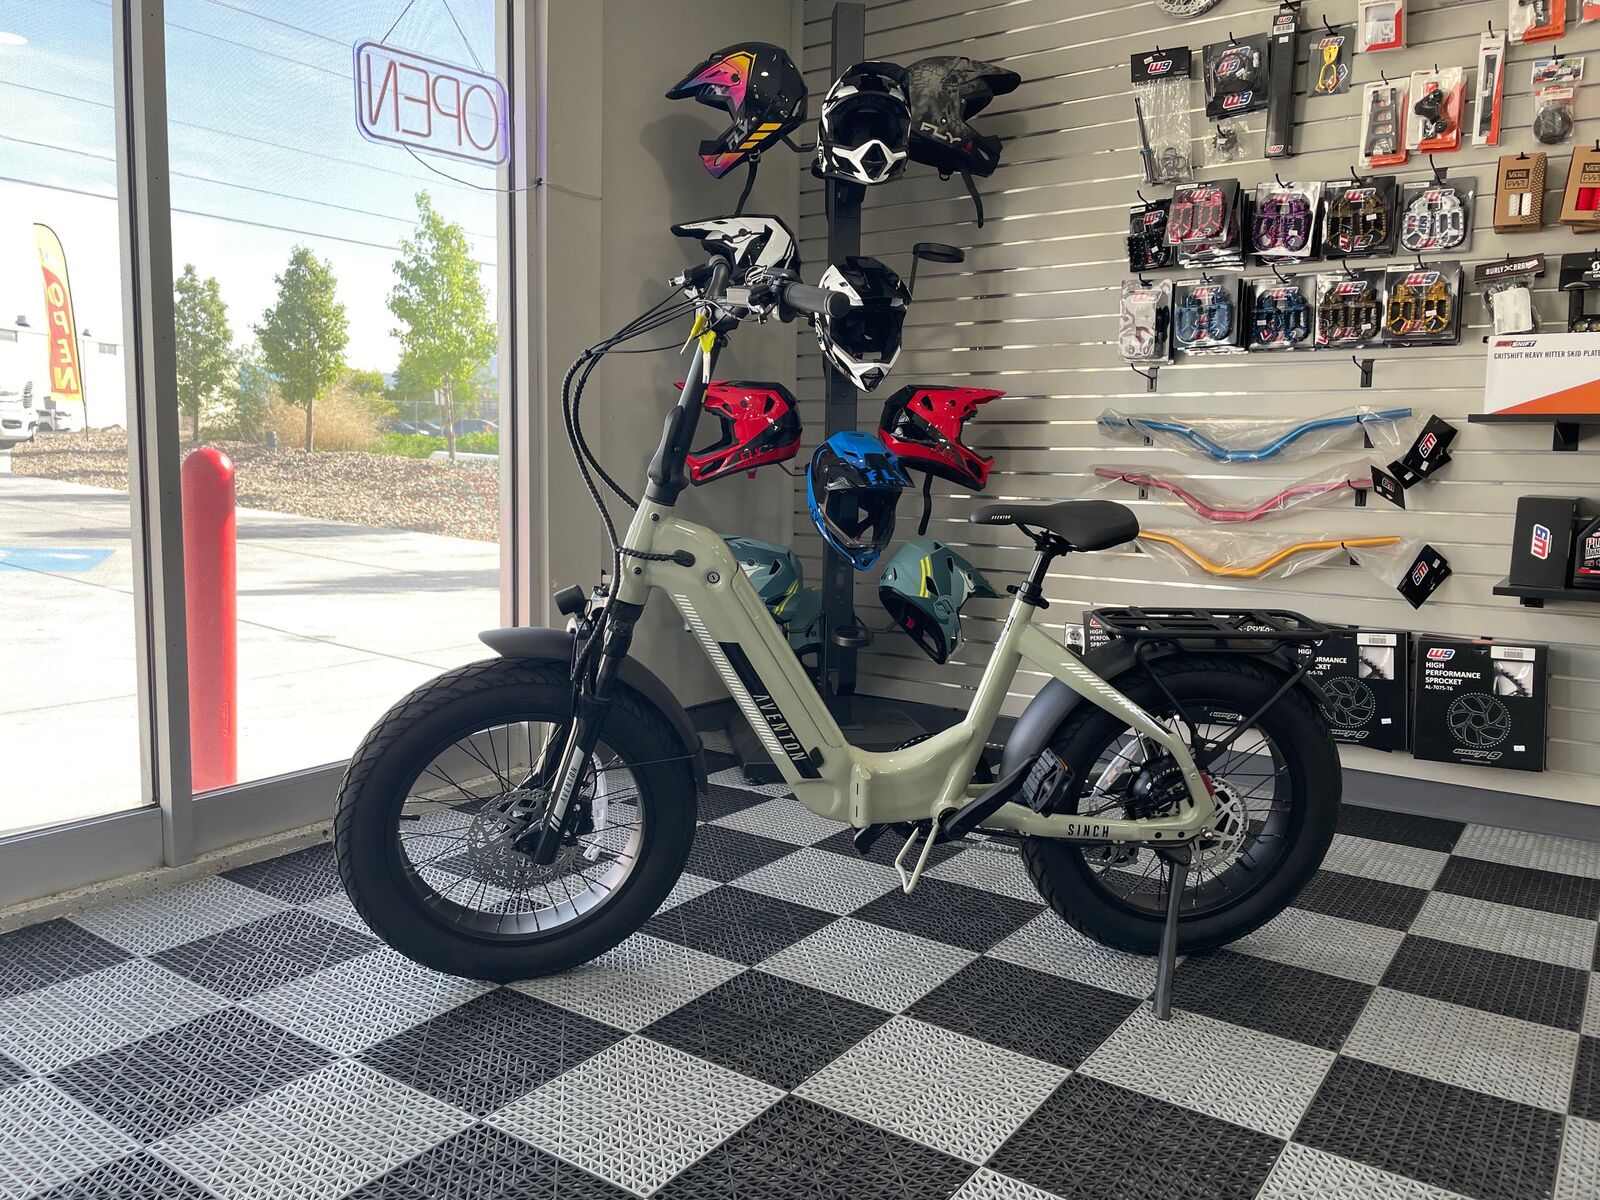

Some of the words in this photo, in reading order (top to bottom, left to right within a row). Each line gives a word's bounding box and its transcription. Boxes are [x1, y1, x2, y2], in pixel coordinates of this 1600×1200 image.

[1148, 60, 1172, 74] W9
[1223, 91, 1253, 109] W9
[726, 117, 748, 150] FLY
[920, 122, 961, 144] FLY
[1485, 267, 1504, 276] BURLY
[1524, 351, 1543, 359] HEAVY
[1530, 524, 1550, 560] W9
[1426, 648, 1456, 660] W9
[1424, 669, 1481, 680] PERFORMANCE
[1424, 677, 1462, 686] SPROCKET
[752, 694, 808, 760] AVENTON
[560, 766, 578, 804] AVENTON
[1068, 824, 1110, 838] SINCH
